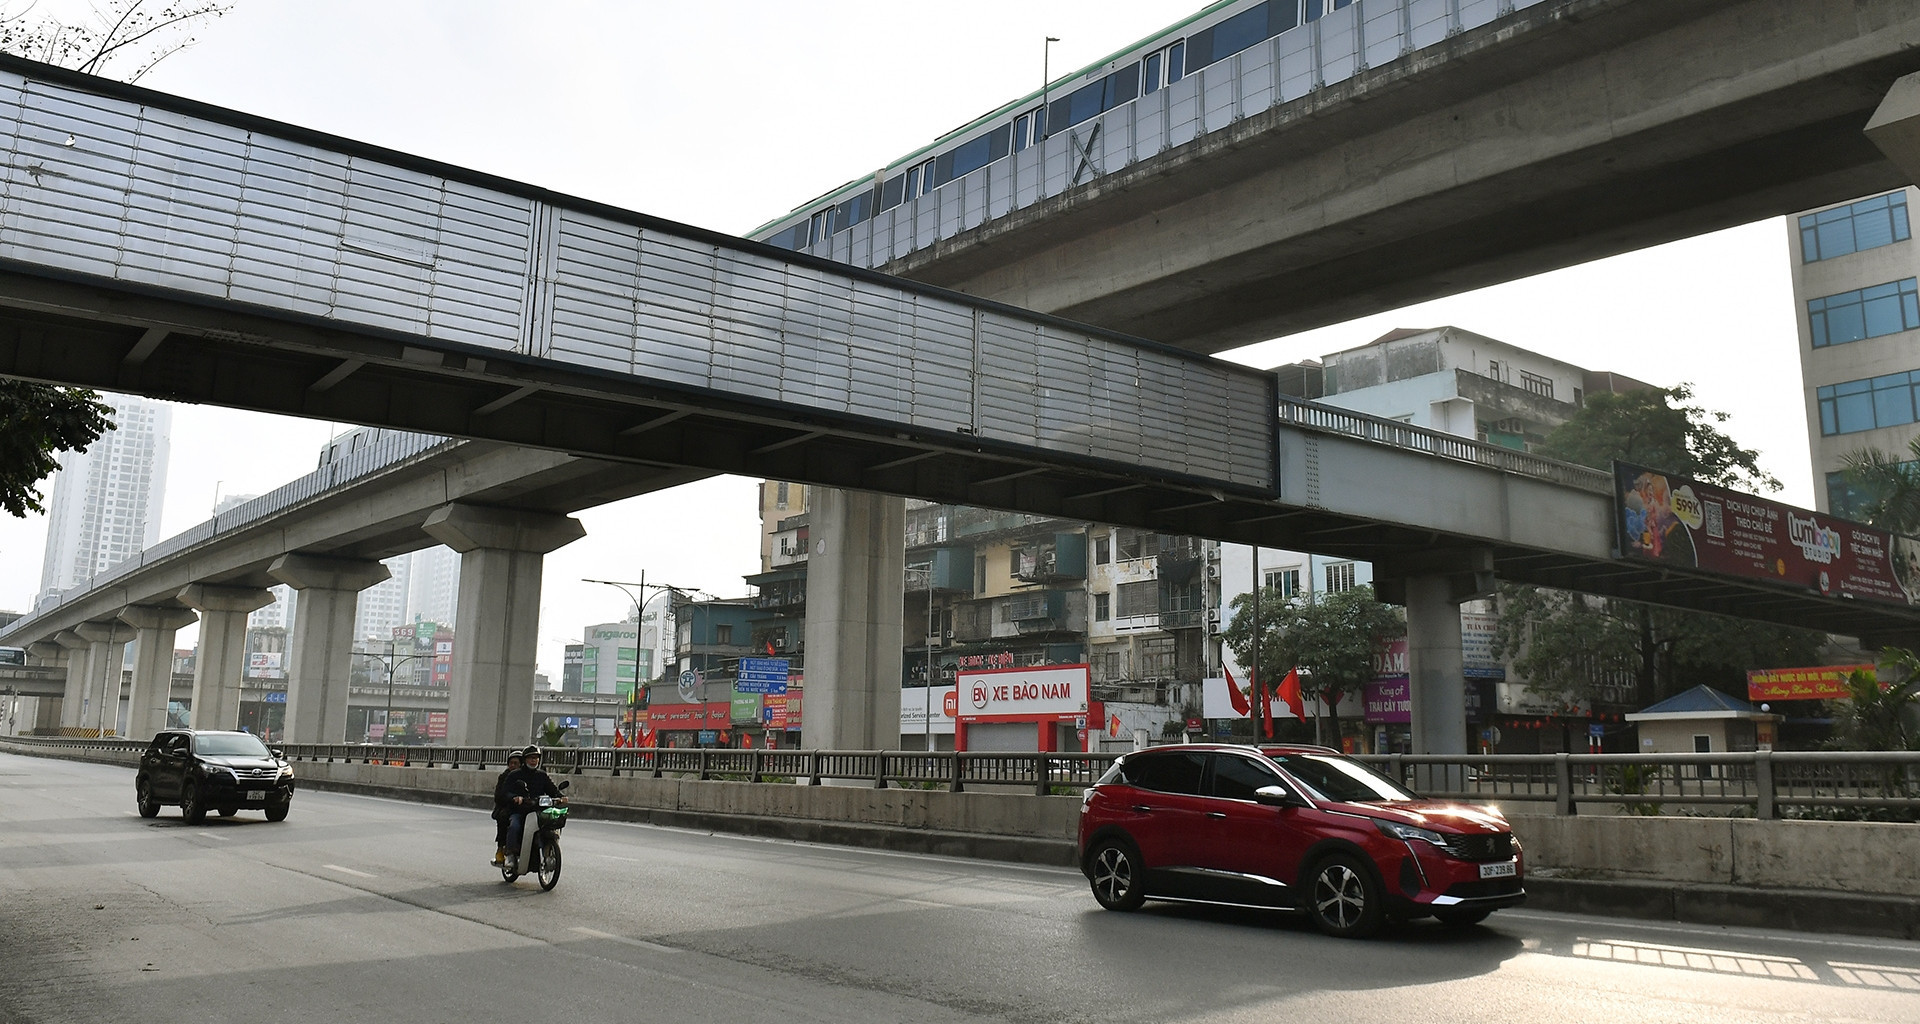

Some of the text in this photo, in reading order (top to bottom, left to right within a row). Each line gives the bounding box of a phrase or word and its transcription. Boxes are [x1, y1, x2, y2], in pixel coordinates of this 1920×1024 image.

[1676, 498, 1700, 515] 599K
[1726, 500, 1741, 513] DỊCH
[1740, 503, 1749, 516] VỤ
[1750, 506, 1766, 518] CHỤP
[1736, 516, 1751, 528] THEO
[1752, 517, 1764, 531] CHỦ
[1804, 545, 1830, 561] STUDIO
[592, 628, 637, 640] Kangaroo
[973, 687, 987, 702] BN
[992, 686, 1009, 701] XE
[1042, 682, 1071, 699] NAM
[1379, 685, 1404, 697] King of
[1369, 700, 1383, 712] TRÁI
[1384, 699, 1396, 712] CÂY
